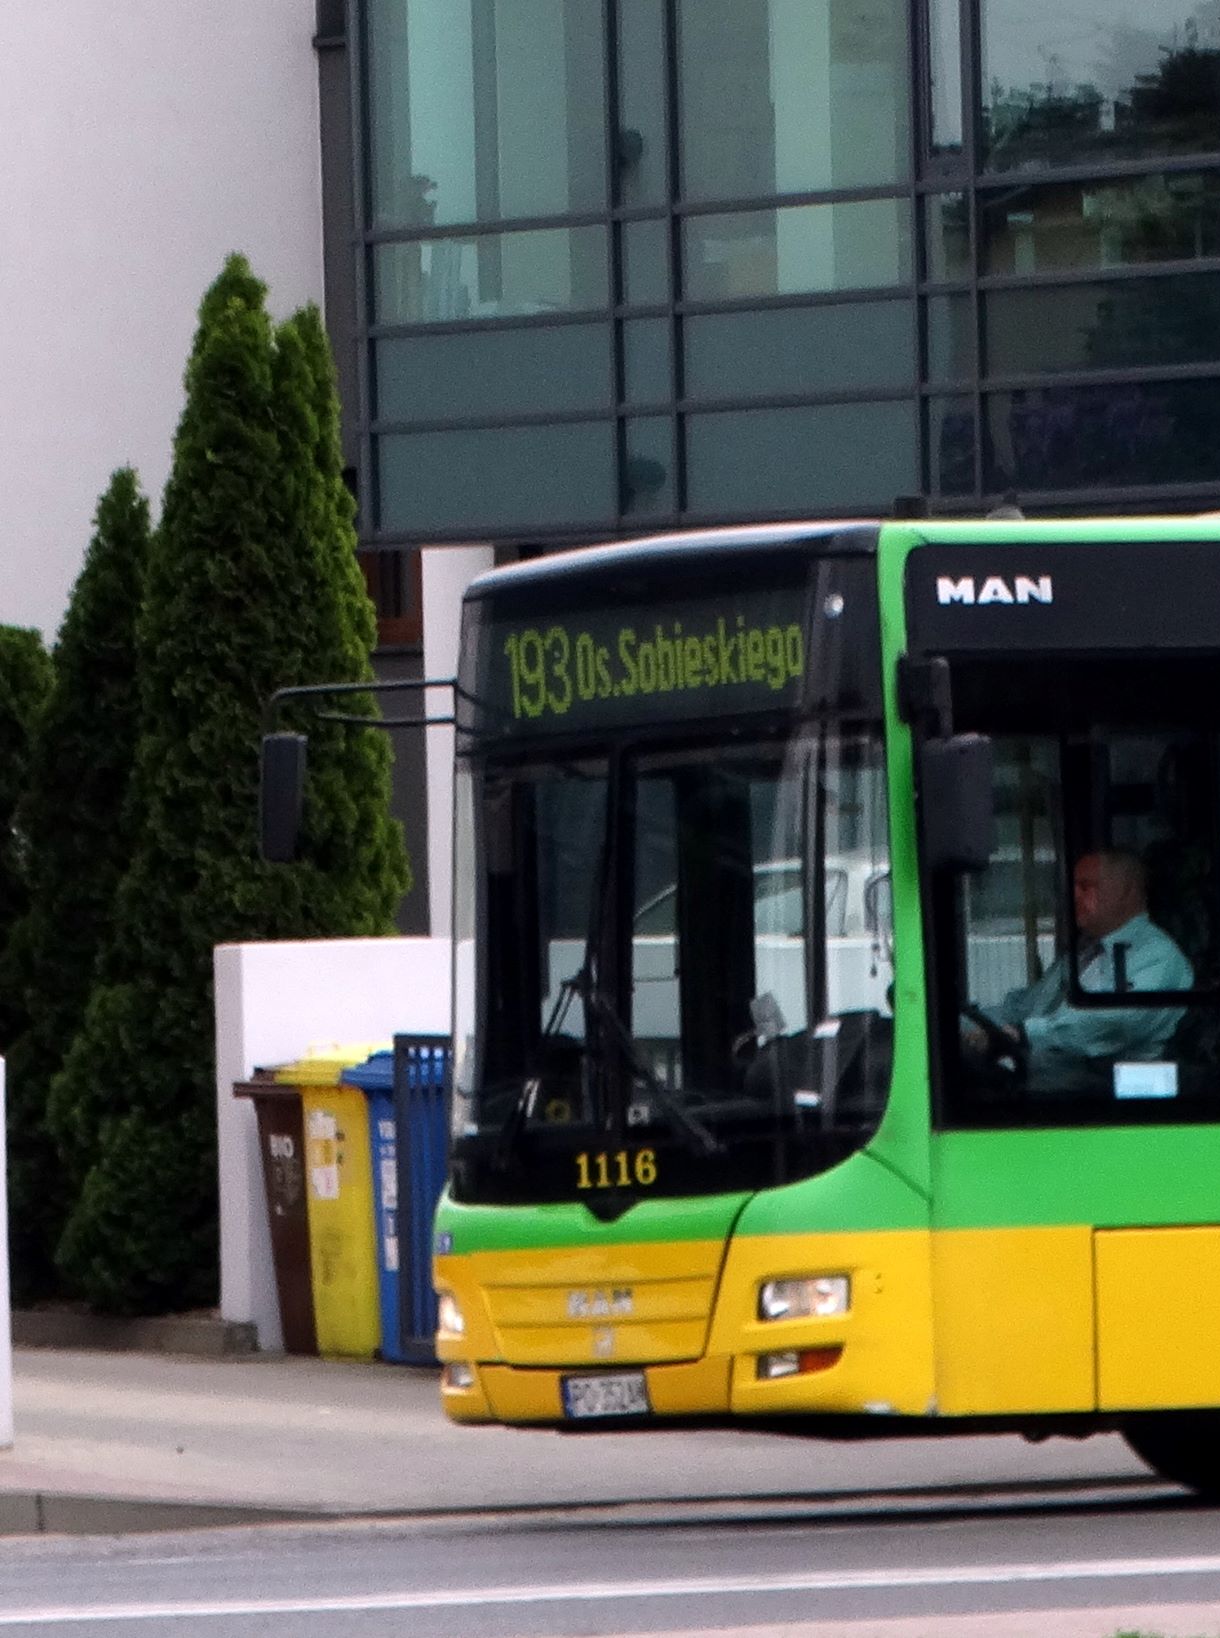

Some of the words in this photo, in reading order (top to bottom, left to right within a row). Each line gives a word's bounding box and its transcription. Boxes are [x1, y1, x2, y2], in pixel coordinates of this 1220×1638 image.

[935, 575, 1054, 605] MAN
[504, 626, 573, 718] 193
[575, 1148, 658, 1189] 1116
